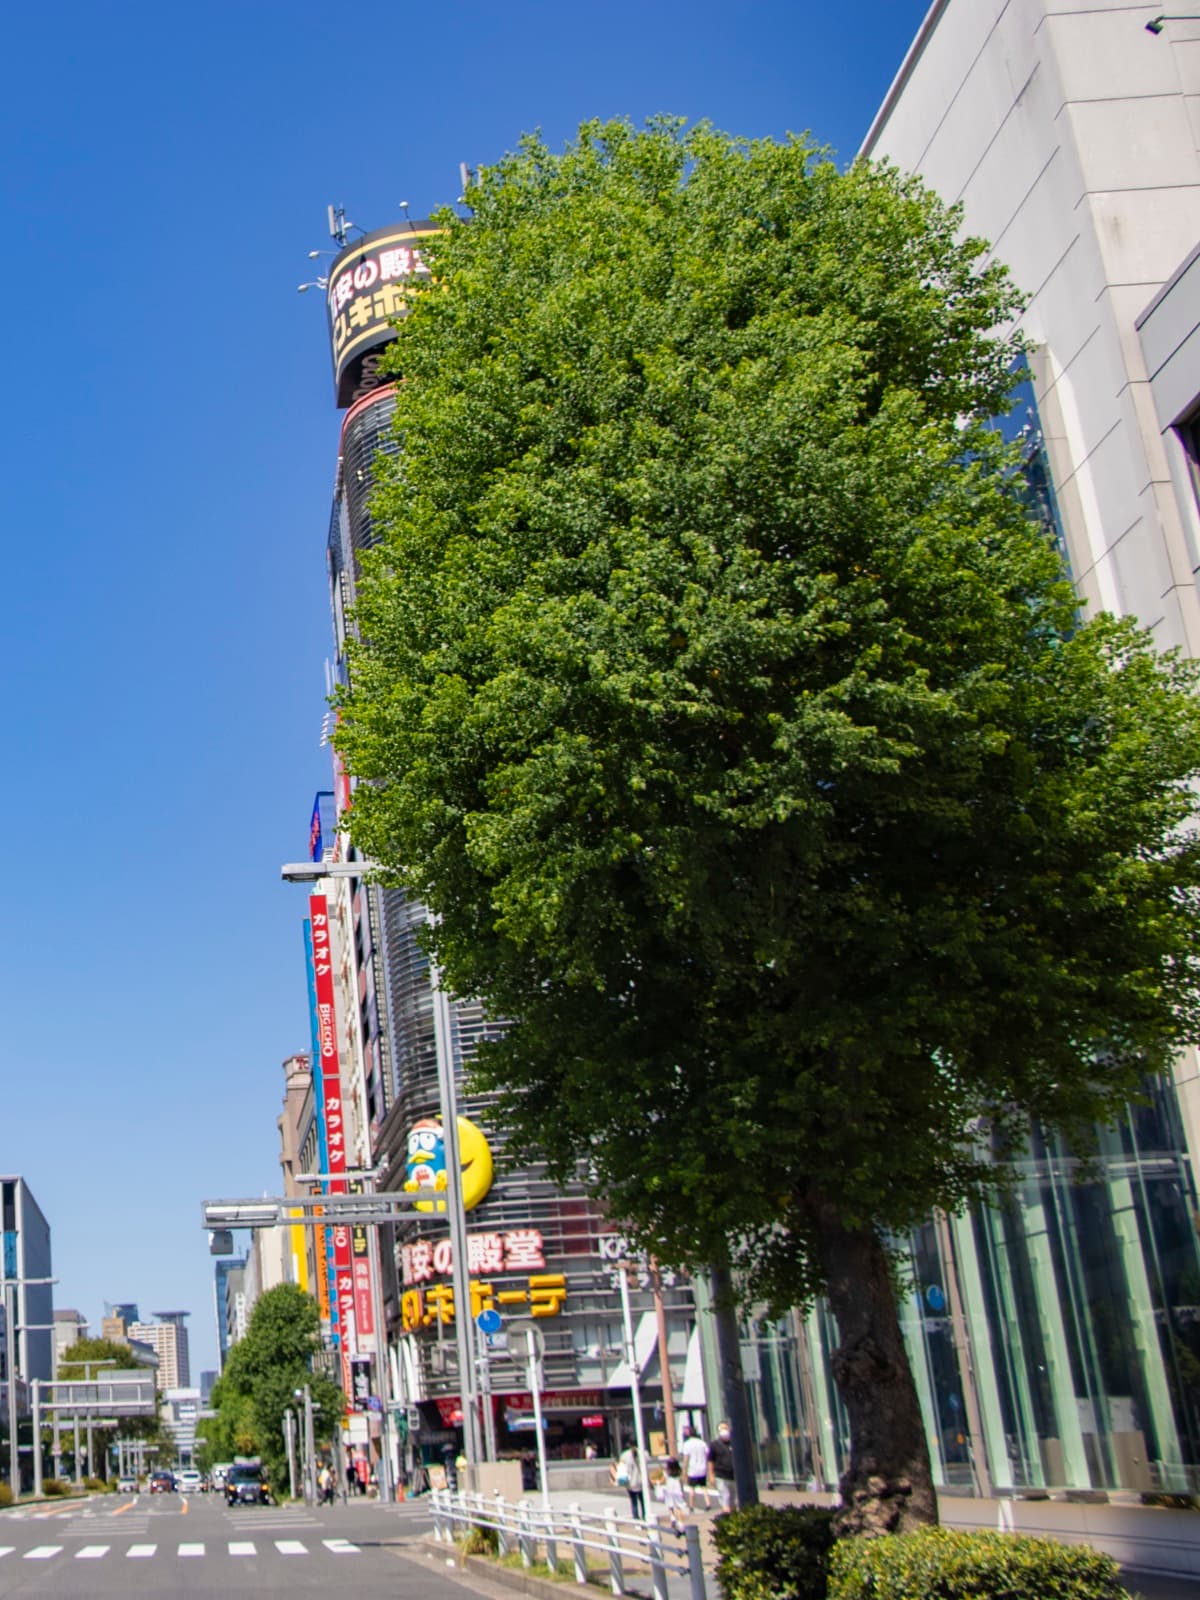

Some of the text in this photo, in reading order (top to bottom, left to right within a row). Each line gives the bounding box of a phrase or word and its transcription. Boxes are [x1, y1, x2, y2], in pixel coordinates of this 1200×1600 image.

[312, 913, 331, 977] カラオケ
[326, 1097, 344, 1164] カラオケ
